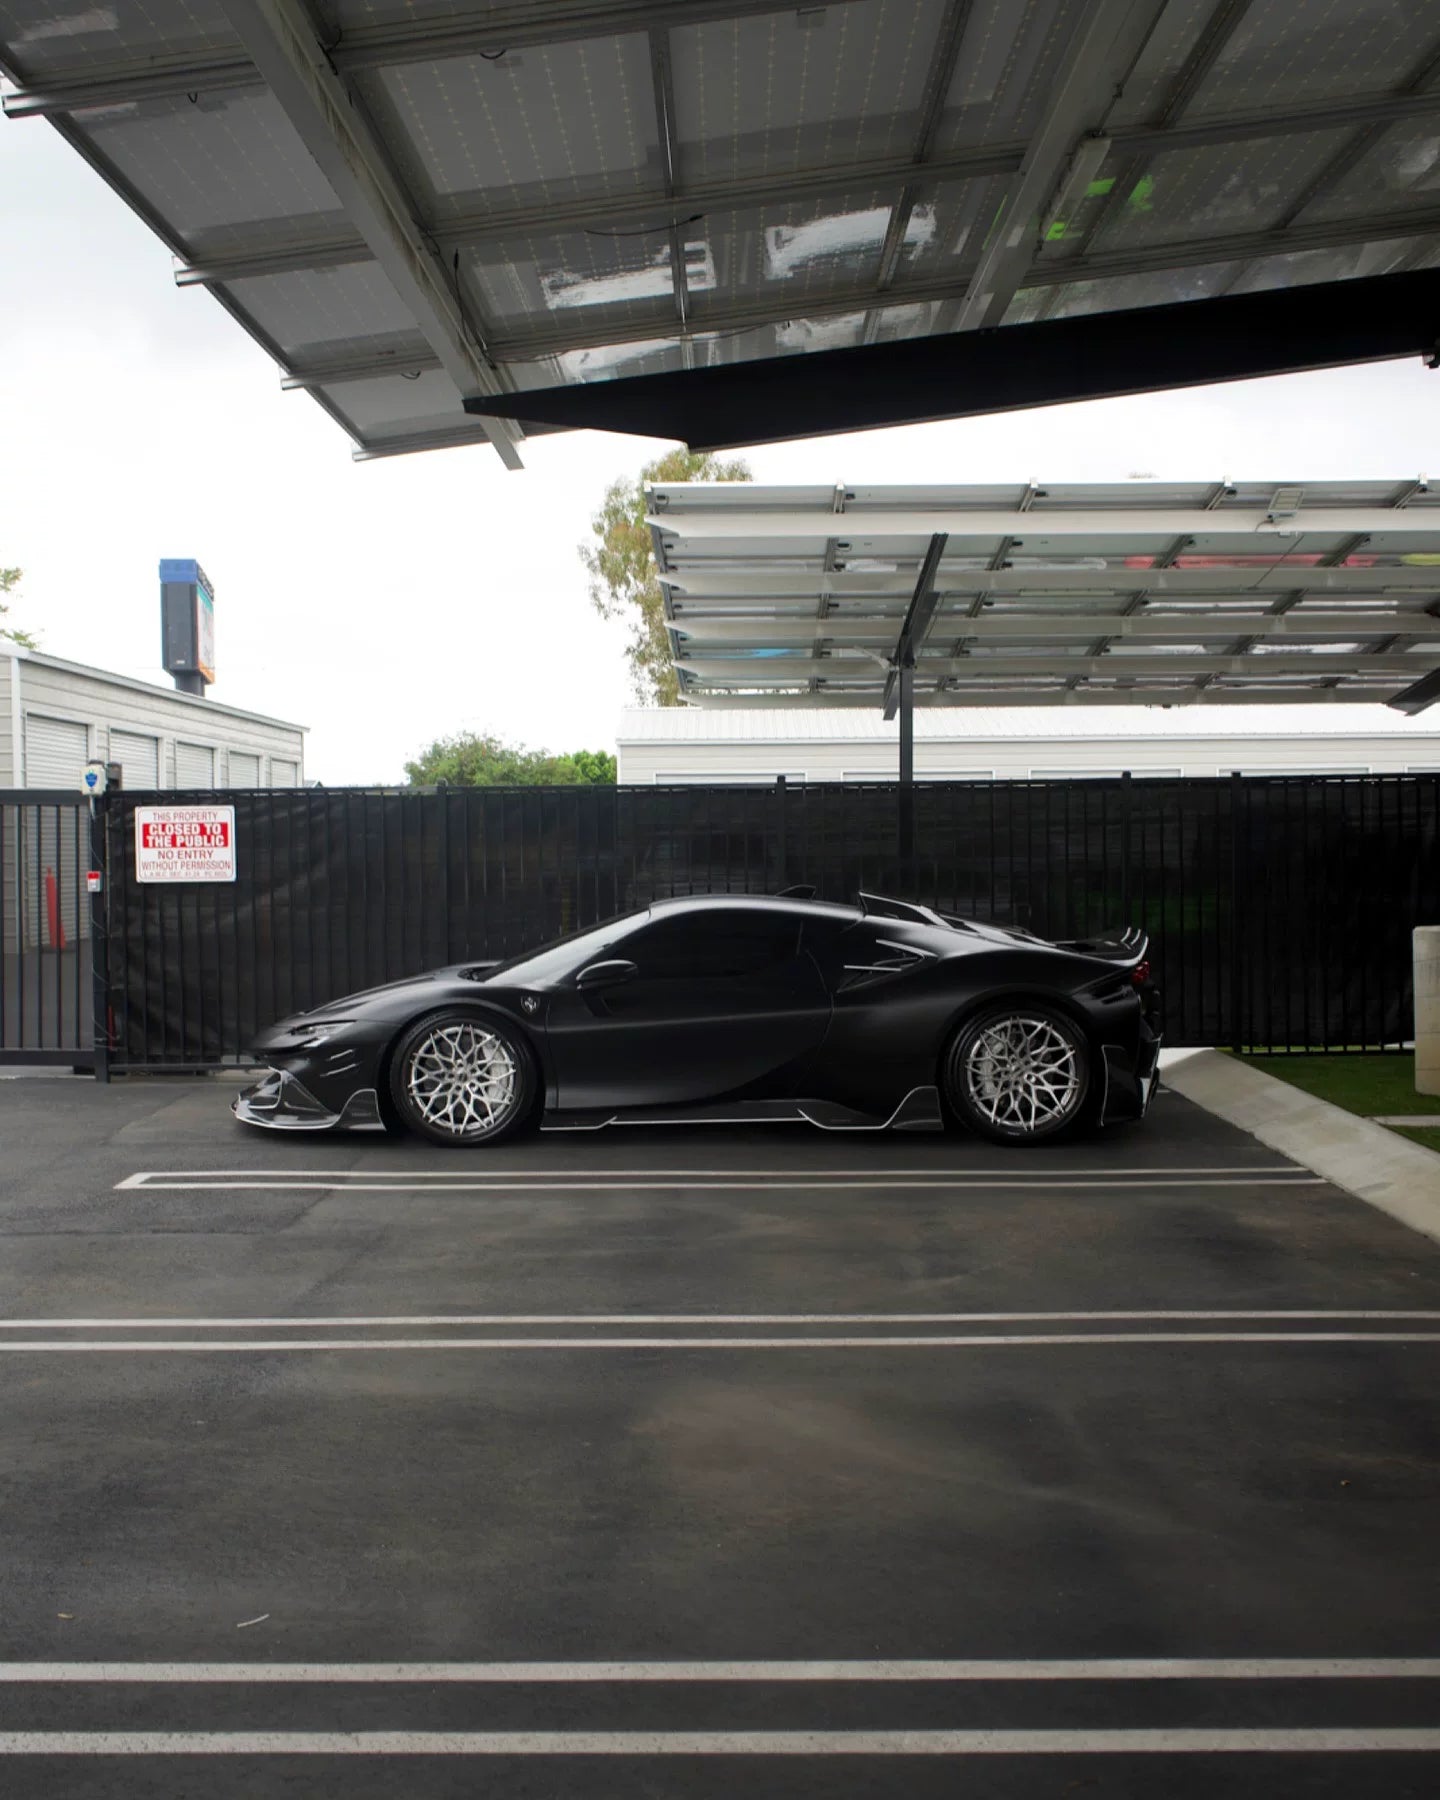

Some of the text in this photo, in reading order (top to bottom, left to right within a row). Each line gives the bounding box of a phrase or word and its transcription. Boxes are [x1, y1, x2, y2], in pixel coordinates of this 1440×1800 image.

[153, 811, 218, 820] THIS PROPERTY
[149, 823, 222, 835] CLOSED TO
[147, 835, 224, 847] THE PUBLIC
[158, 850, 214, 860] NO ENTRY
[142, 860, 231, 870] WITHOUT PERMISSION
